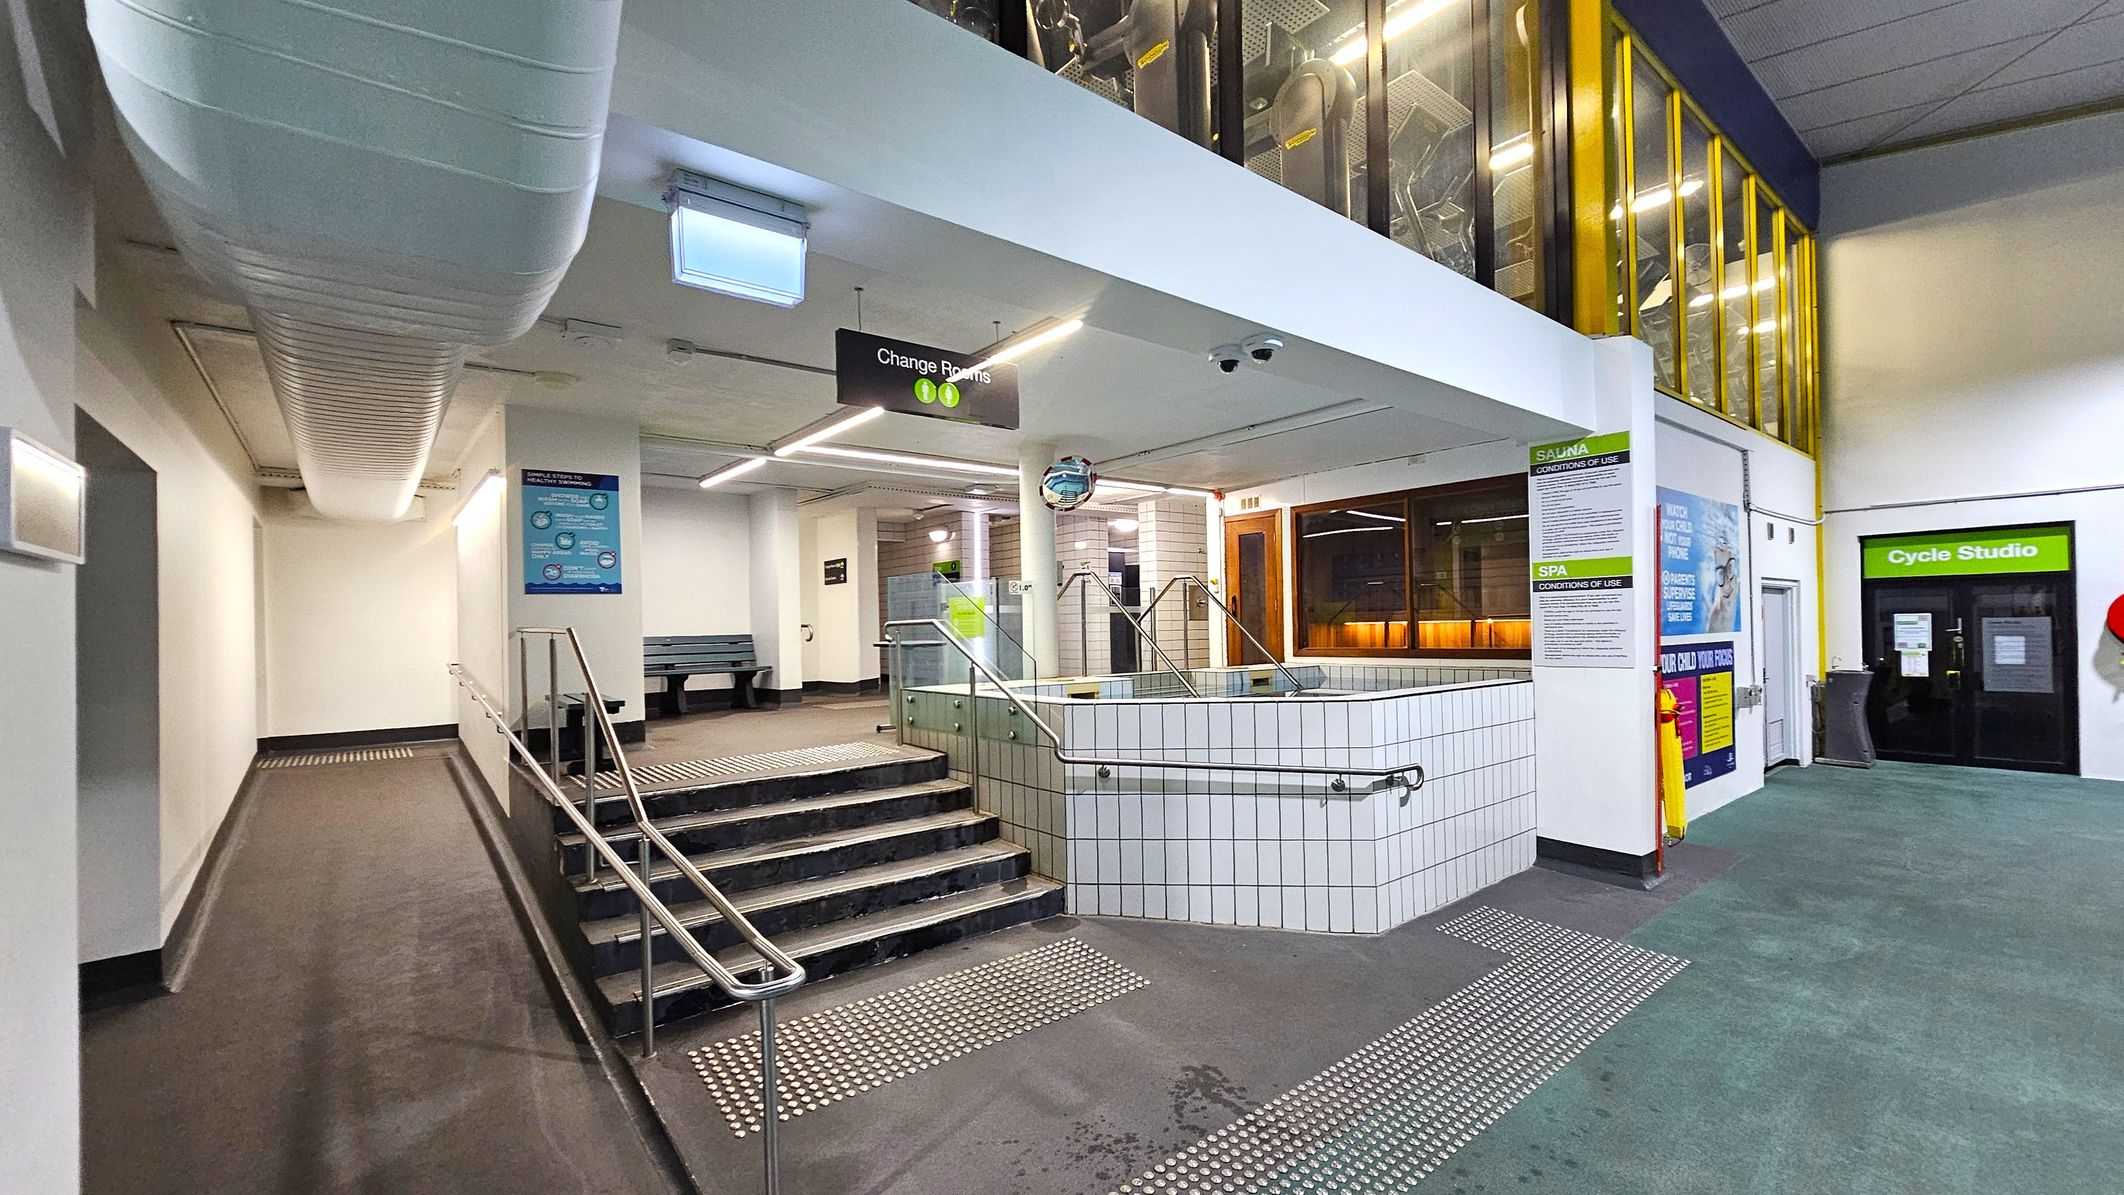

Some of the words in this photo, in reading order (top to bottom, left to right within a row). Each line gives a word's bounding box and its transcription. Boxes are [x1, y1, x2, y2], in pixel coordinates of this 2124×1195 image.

[877, 348, 938, 376] Change
[1536, 444, 1589, 461] SAUNA
[1536, 460, 1586, 474] CONDITIONS
[1588, 458, 1600, 467] OF
[1601, 456, 1619, 464] USE
[1888, 548, 1952, 566] Cycle
[1957, 543, 2038, 561] Studio
[1538, 564, 1568, 577] SPA
[1538, 581, 1588, 591] CONDITIONS
[1590, 580, 1603, 588] OF
[1604, 579, 1622, 588] USE
[1670, 573, 1696, 586] PARENTS
[1663, 586, 1696, 600] SUPERVISE
[1678, 652, 1697, 671] CHILD
[1697, 650, 1714, 670] YOUR
[1714, 648, 1734, 668] FOCUS
